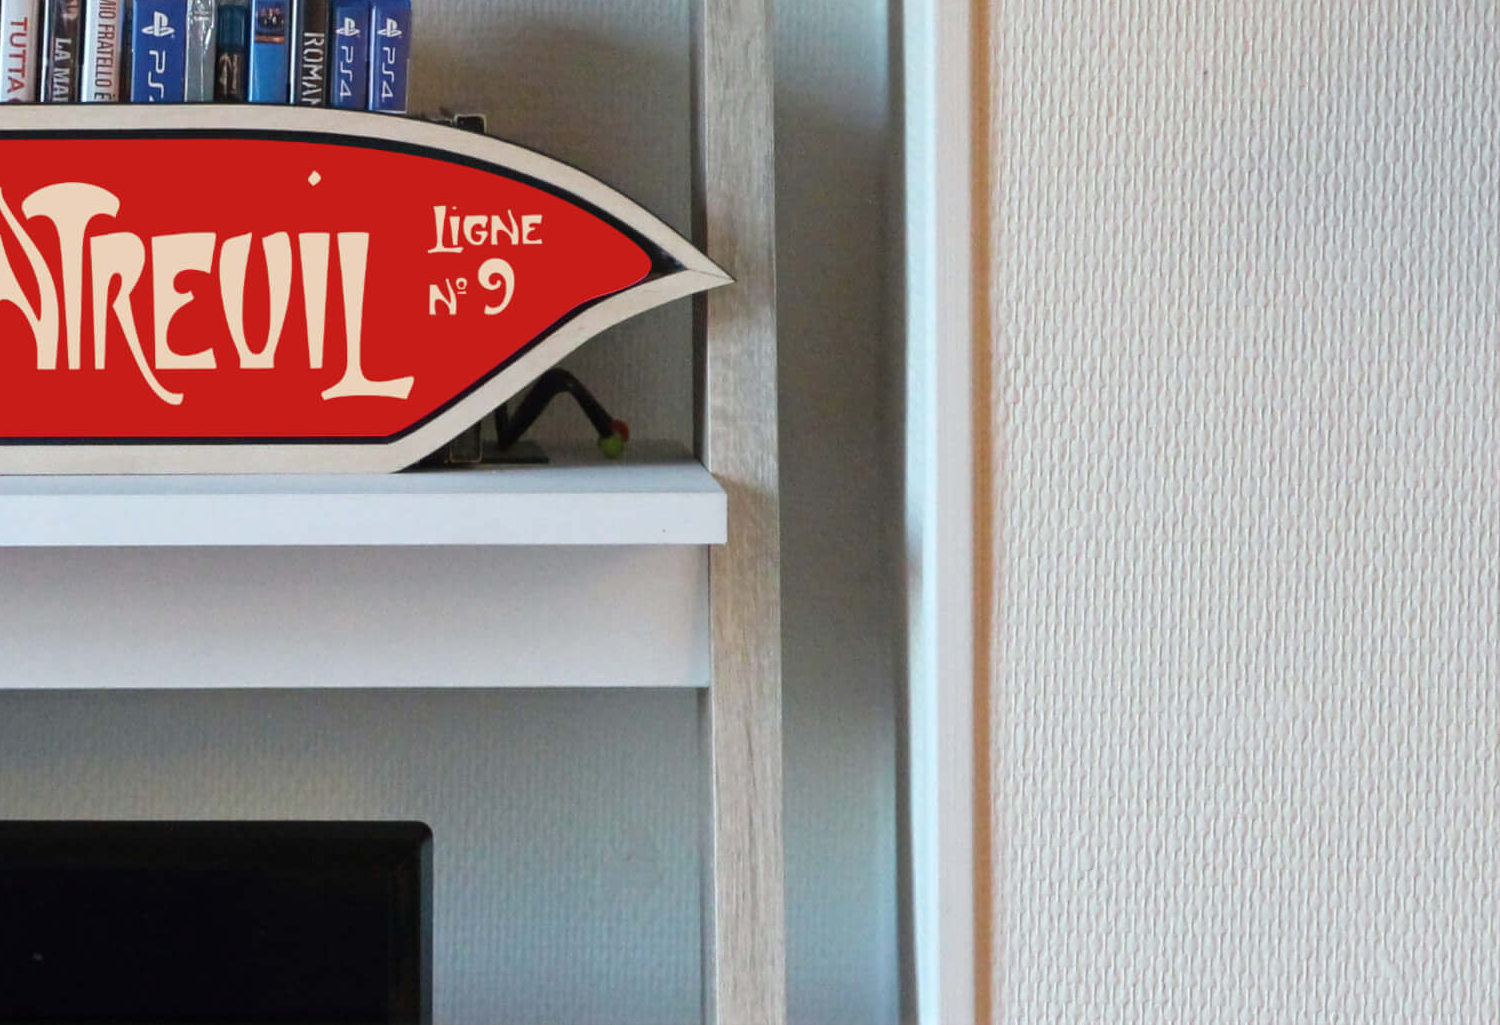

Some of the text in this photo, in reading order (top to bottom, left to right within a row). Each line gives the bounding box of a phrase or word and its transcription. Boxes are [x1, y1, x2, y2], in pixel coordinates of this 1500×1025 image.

[55, 37, 72, 61] LA
[95, 24, 116, 88] FRATELLO
[148, 50, 166, 102] PS
[339, 45, 354, 103] PS4
[380, 46, 396, 103] PS4
[478, 258, 515, 315] 9
